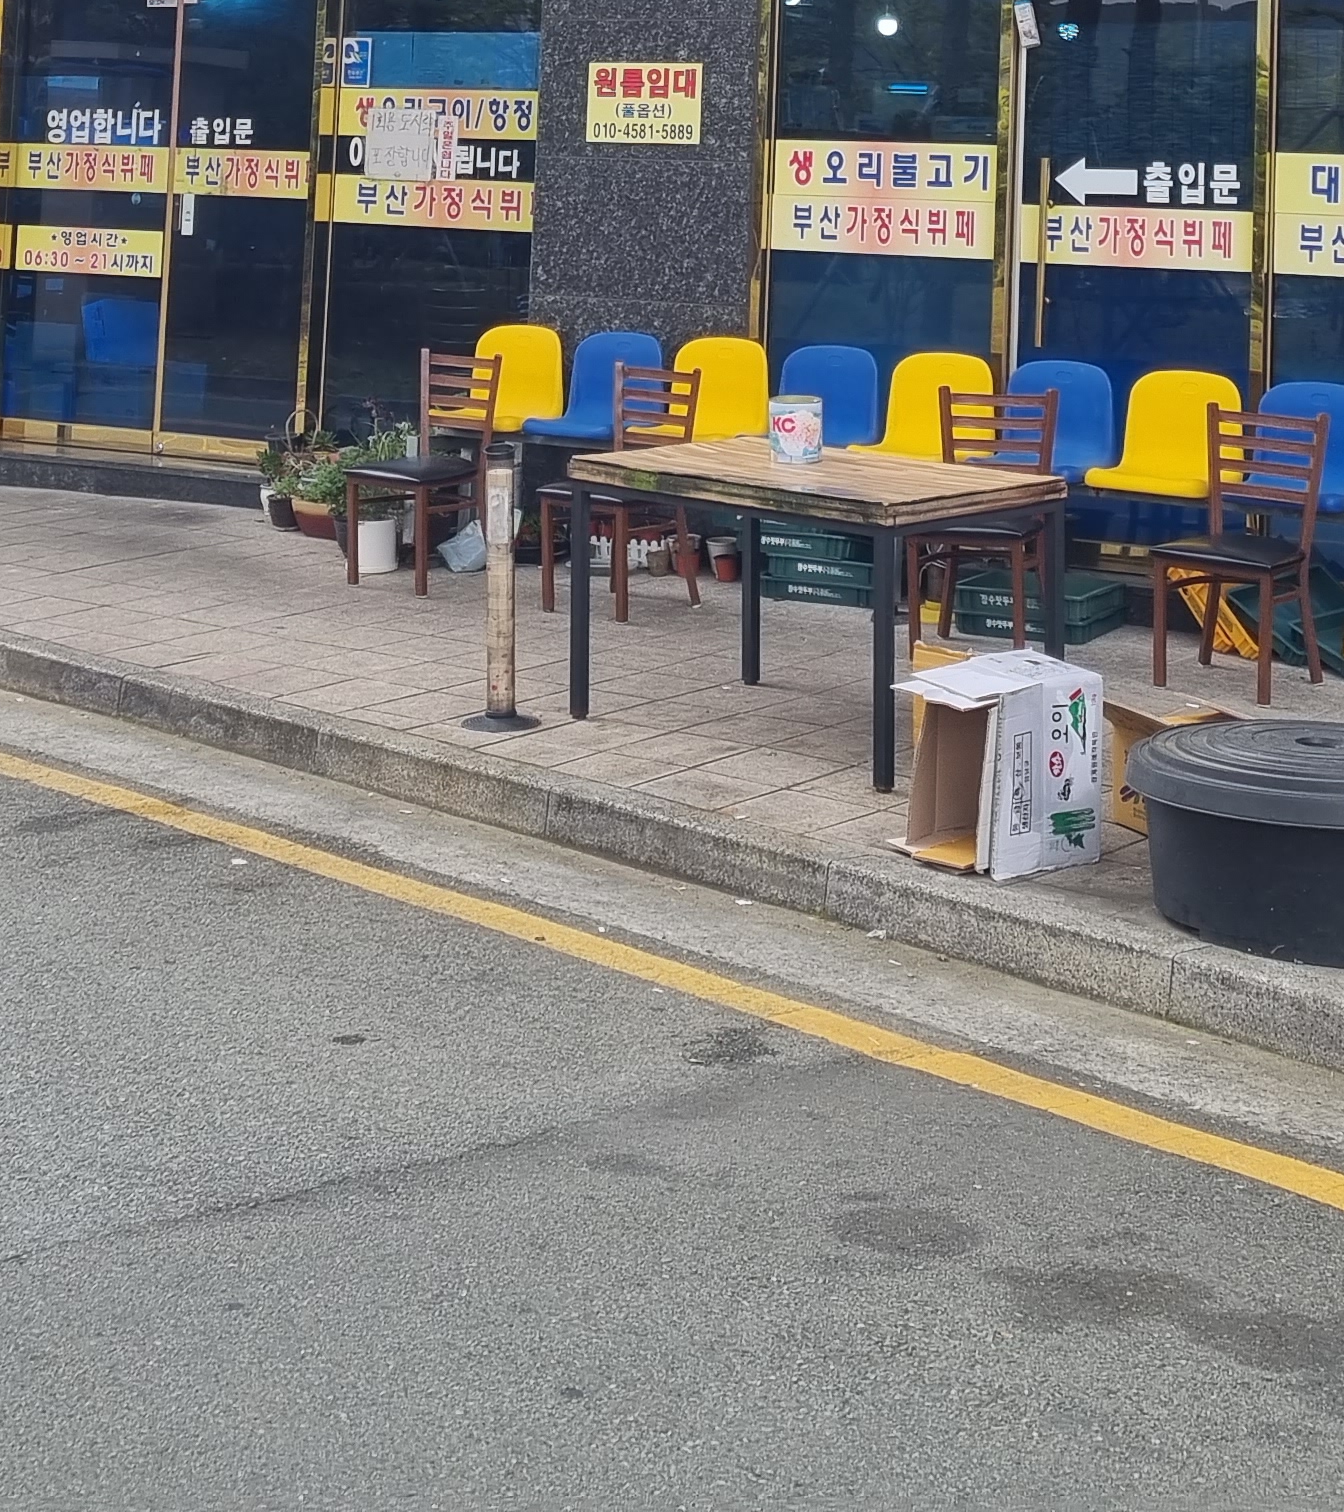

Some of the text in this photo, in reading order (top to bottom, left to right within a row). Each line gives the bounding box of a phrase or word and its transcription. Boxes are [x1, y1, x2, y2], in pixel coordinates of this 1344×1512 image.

[46, 107, 162, 145] 영업합니다
[615, 103, 672, 120] (풀옵션)
[189, 117, 254, 145] 출입문
[593, 122, 693, 140] 010-4581-5889
[27, 150, 155, 184] 부산가정식뷔페
[185, 155, 311, 189] 부산가정식뷔
[788, 149, 989, 192] 생오리불고기
[1143, 161, 1241, 205] 출입문
[356, 183, 534, 222] 부산가정식뷔
[792, 203, 976, 248] 부산가정식뷔페
[1051, 704, 1069, 744] 오이
